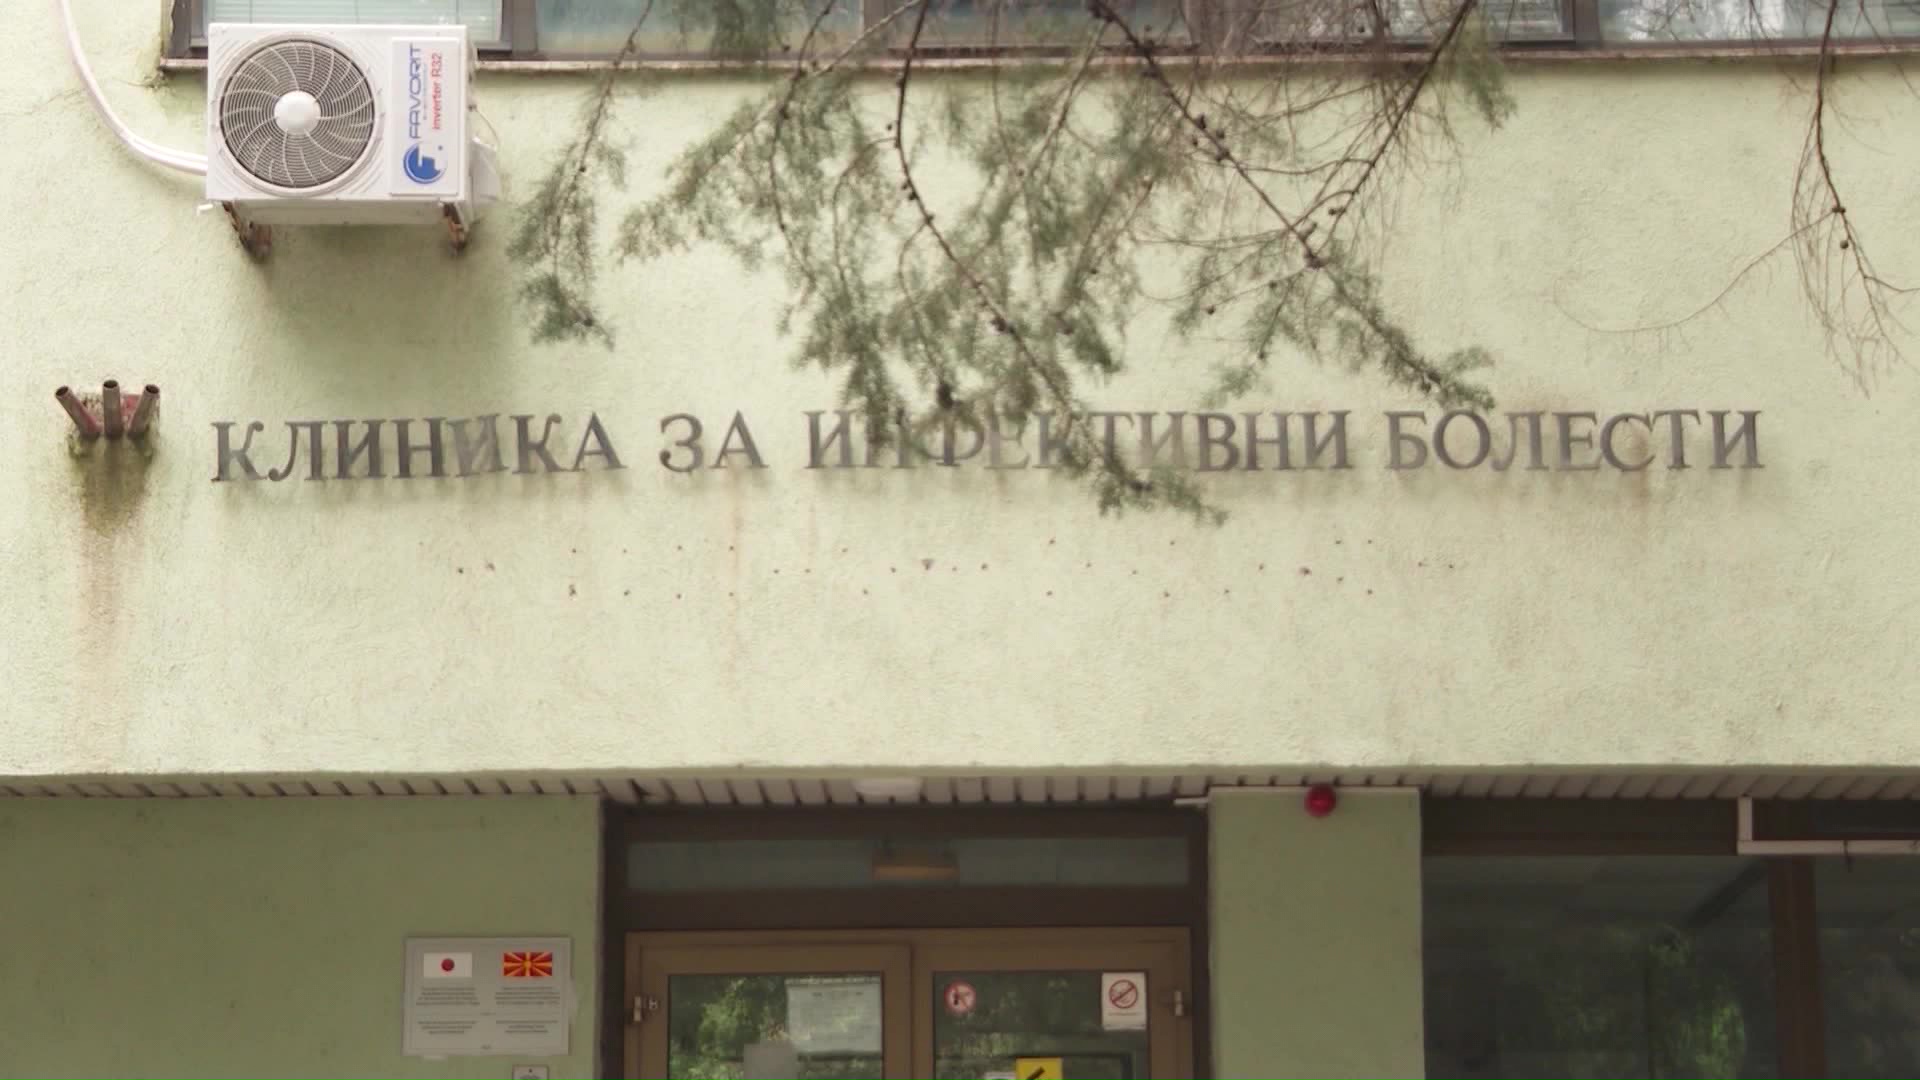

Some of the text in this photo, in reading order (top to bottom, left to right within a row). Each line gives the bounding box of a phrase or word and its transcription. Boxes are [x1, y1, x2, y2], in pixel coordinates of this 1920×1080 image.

[408, 42, 421, 139] FAVORIT
[431, 52, 442, 77] R32
[211, 411, 627, 482] КЛИНИКА
[659, 410, 769, 473] ЗА
[1383, 409, 1766, 472] БОЛЕСТИ
